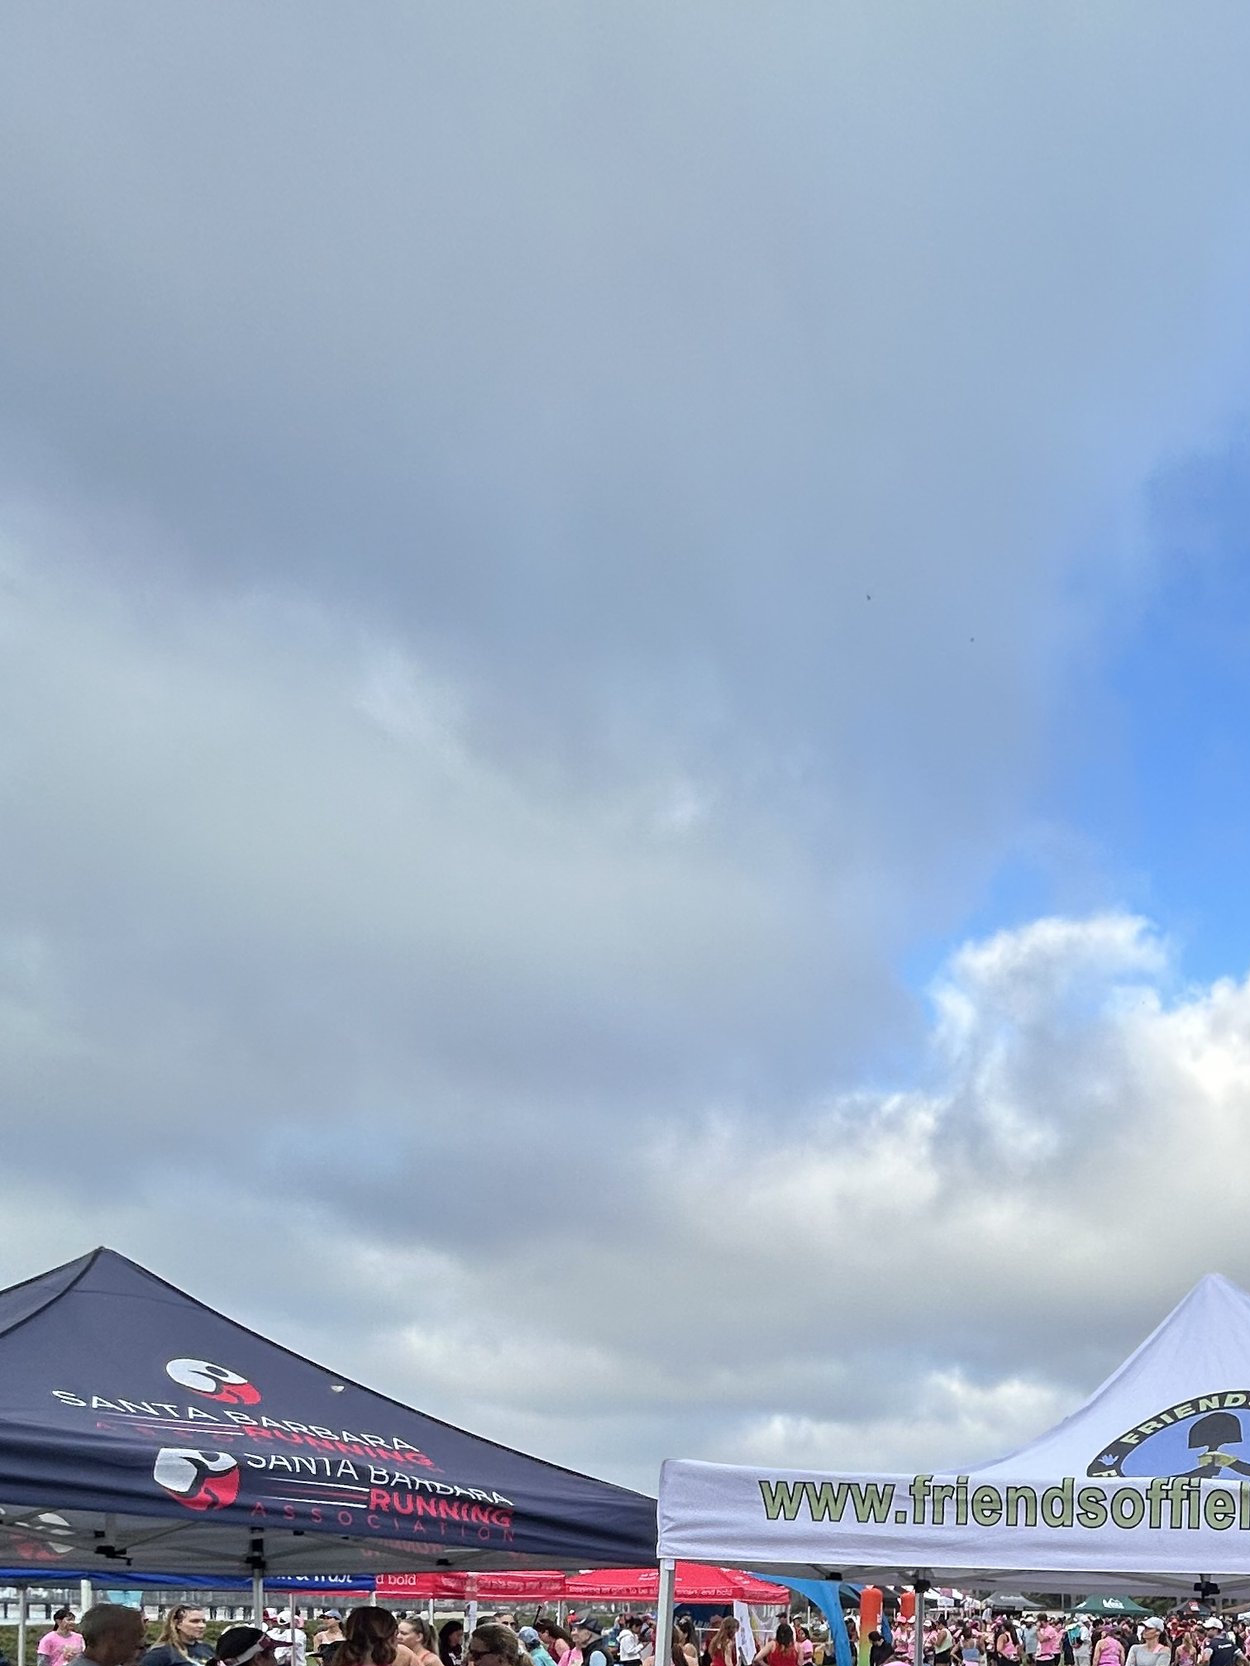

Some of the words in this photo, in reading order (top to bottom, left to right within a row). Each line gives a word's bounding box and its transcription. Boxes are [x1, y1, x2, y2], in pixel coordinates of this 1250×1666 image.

[51, 1389, 221, 1422] SANTA
[223, 1410, 420, 1453] BARBARA
[243, 1452, 360, 1481] SANTA
[250, 1502, 515, 1543] ASSOCIATION
[368, 1488, 514, 1528] RUNNING
[388, 1574, 416, 1586] bold
